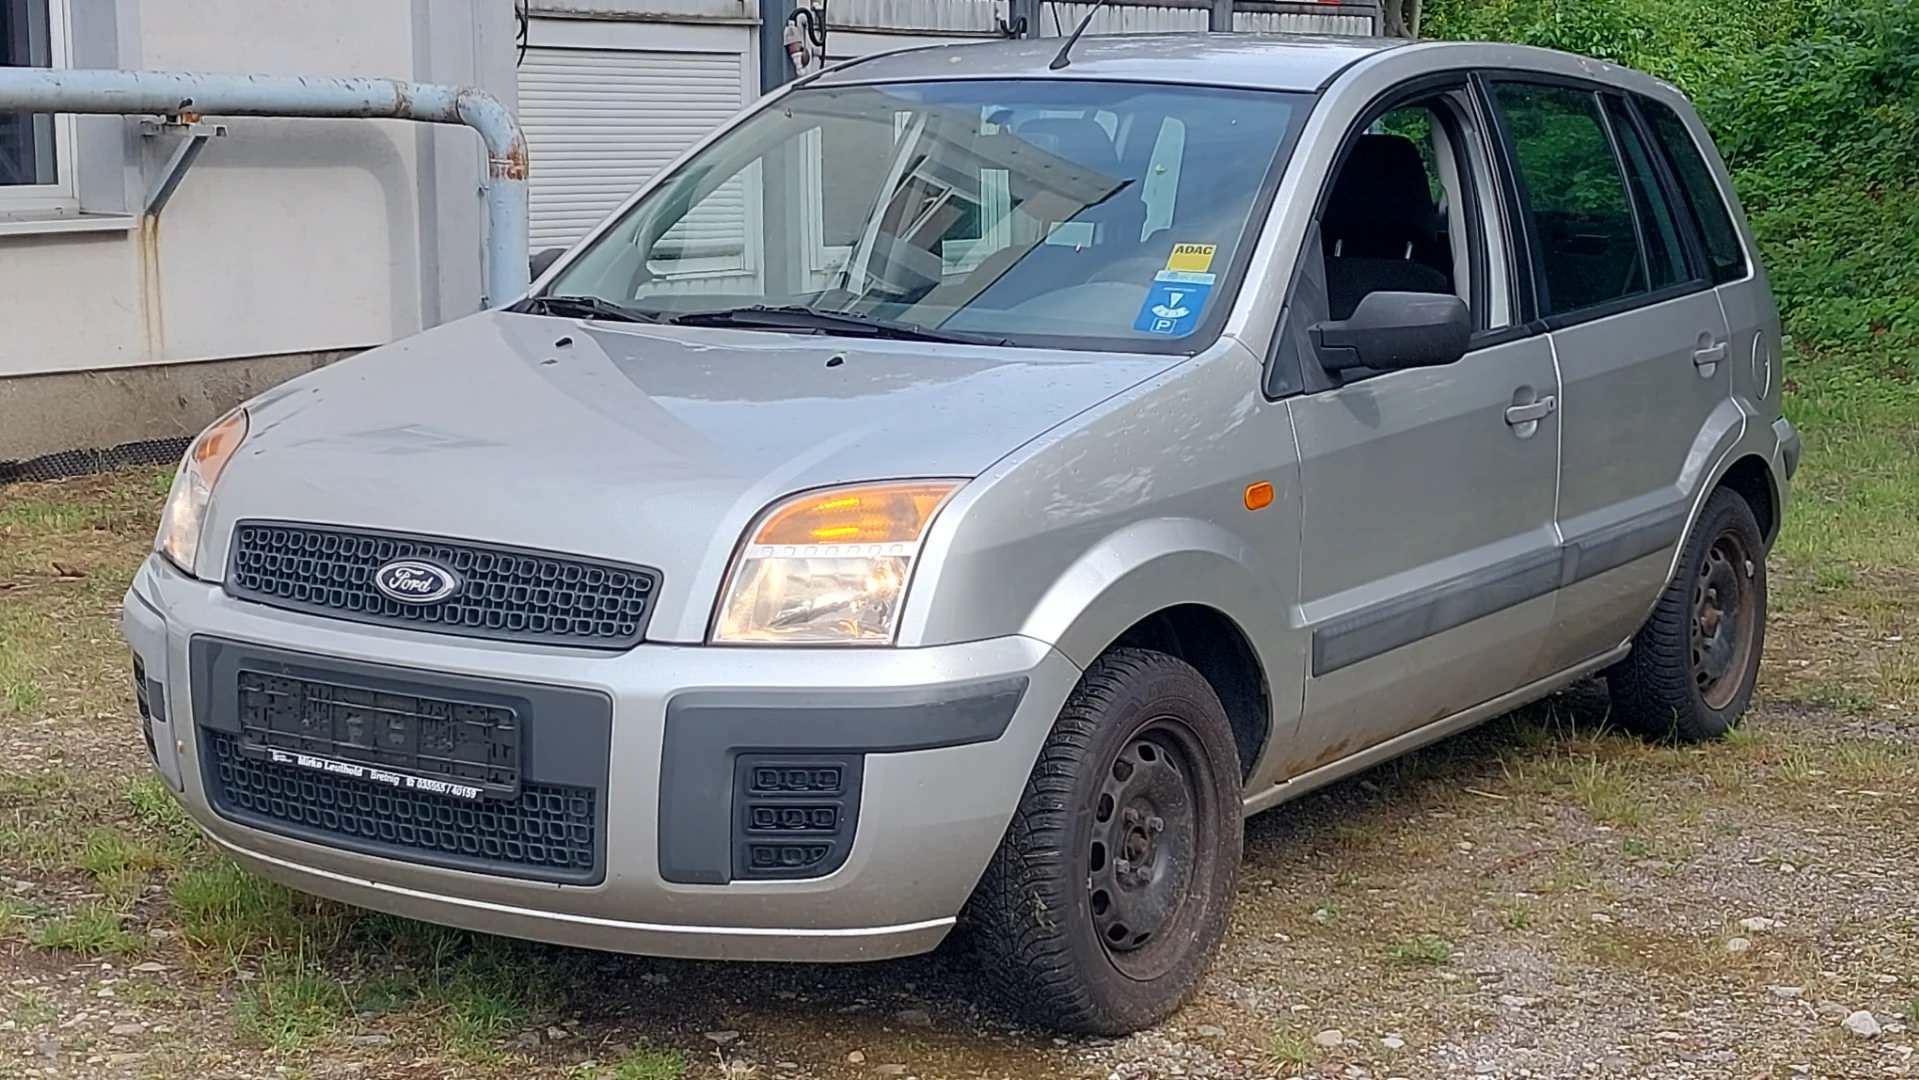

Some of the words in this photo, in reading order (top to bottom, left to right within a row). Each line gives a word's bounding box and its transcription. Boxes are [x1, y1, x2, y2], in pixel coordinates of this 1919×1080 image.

[1174, 245, 1213, 255] ADAC
[1156, 320, 1171, 330] P
[389, 567, 434, 592] Ford
